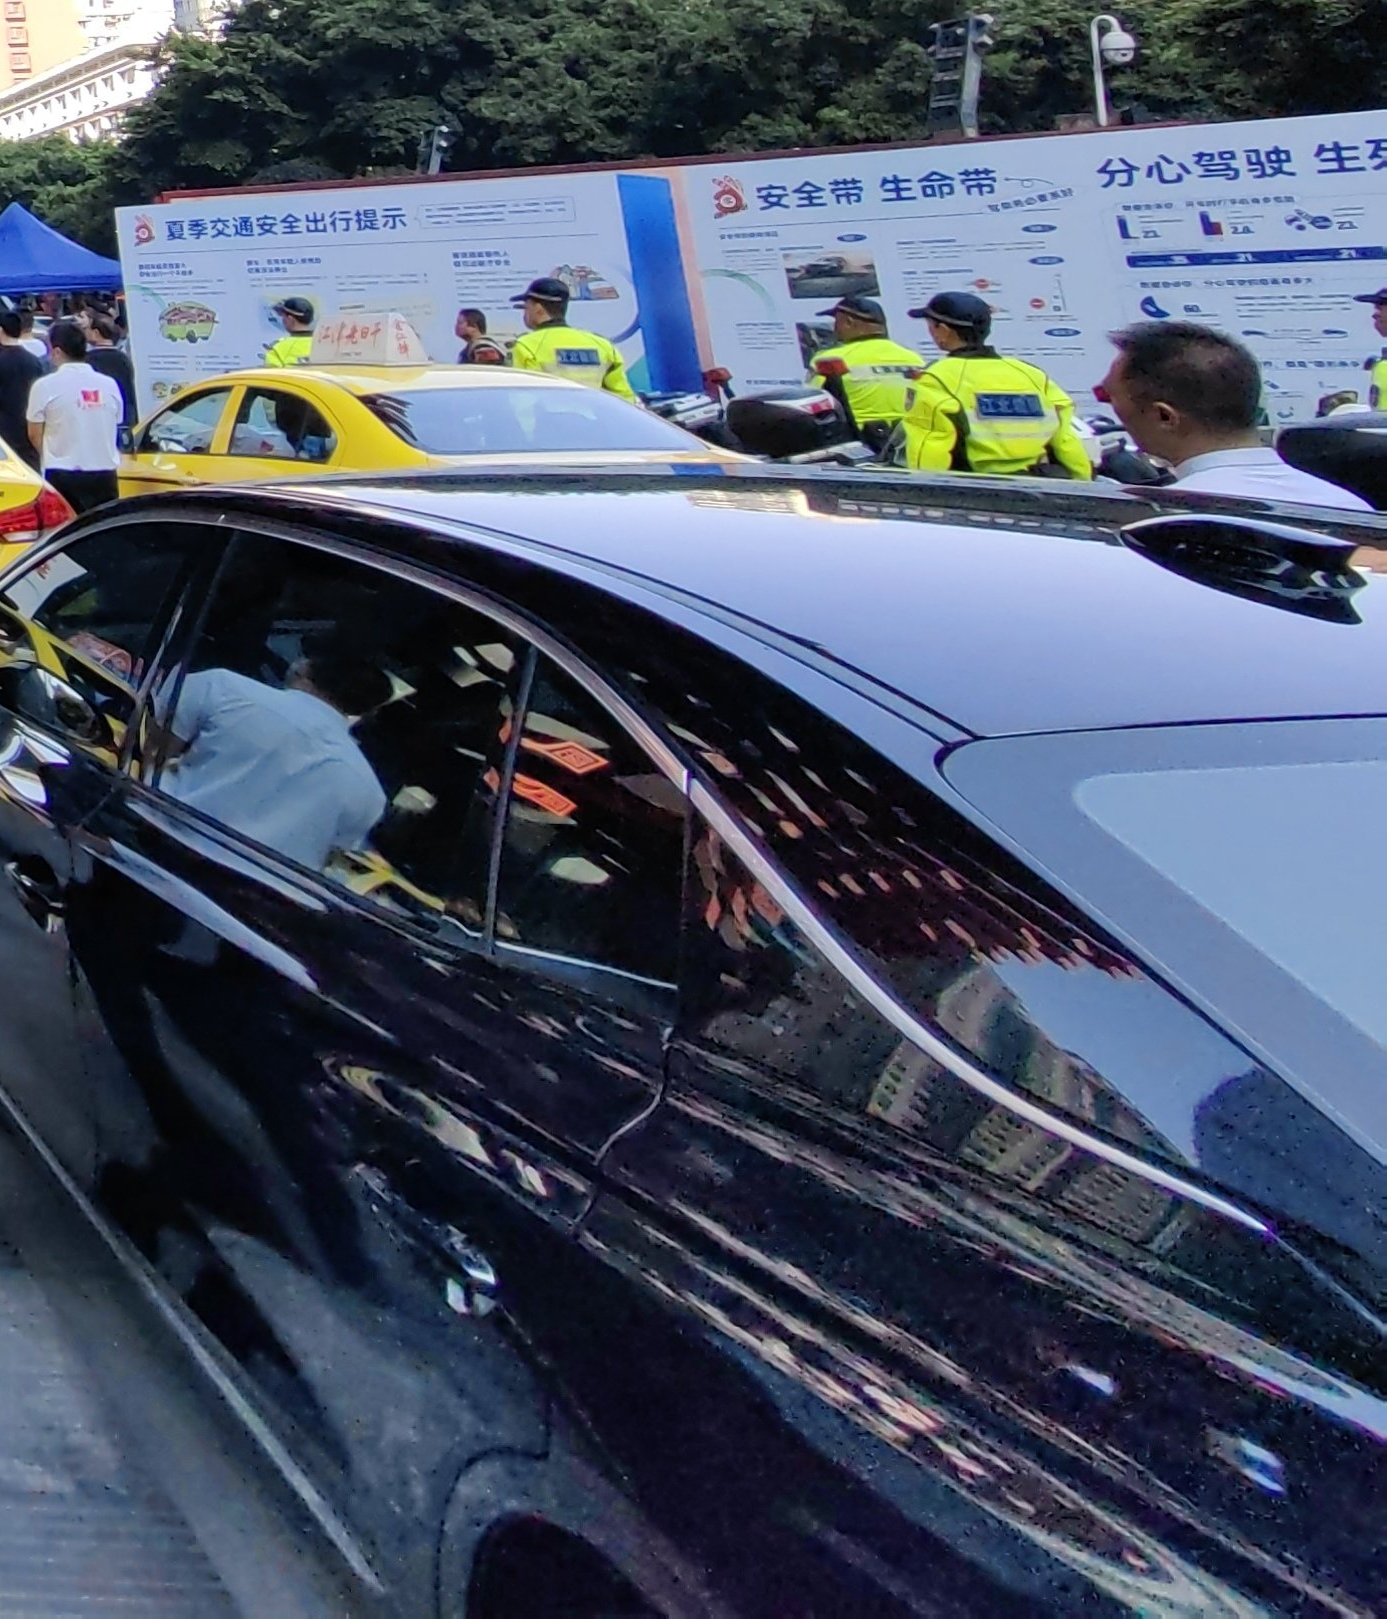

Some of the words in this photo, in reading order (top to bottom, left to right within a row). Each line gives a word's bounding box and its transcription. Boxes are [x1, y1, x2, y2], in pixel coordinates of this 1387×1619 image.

[1095, 145, 1297, 188] 分心驾驶
[755, 177, 864, 212] 安全带
[879, 168, 997, 203] 生命带
[164, 207, 407, 242] 夏季交通安全出行提示
